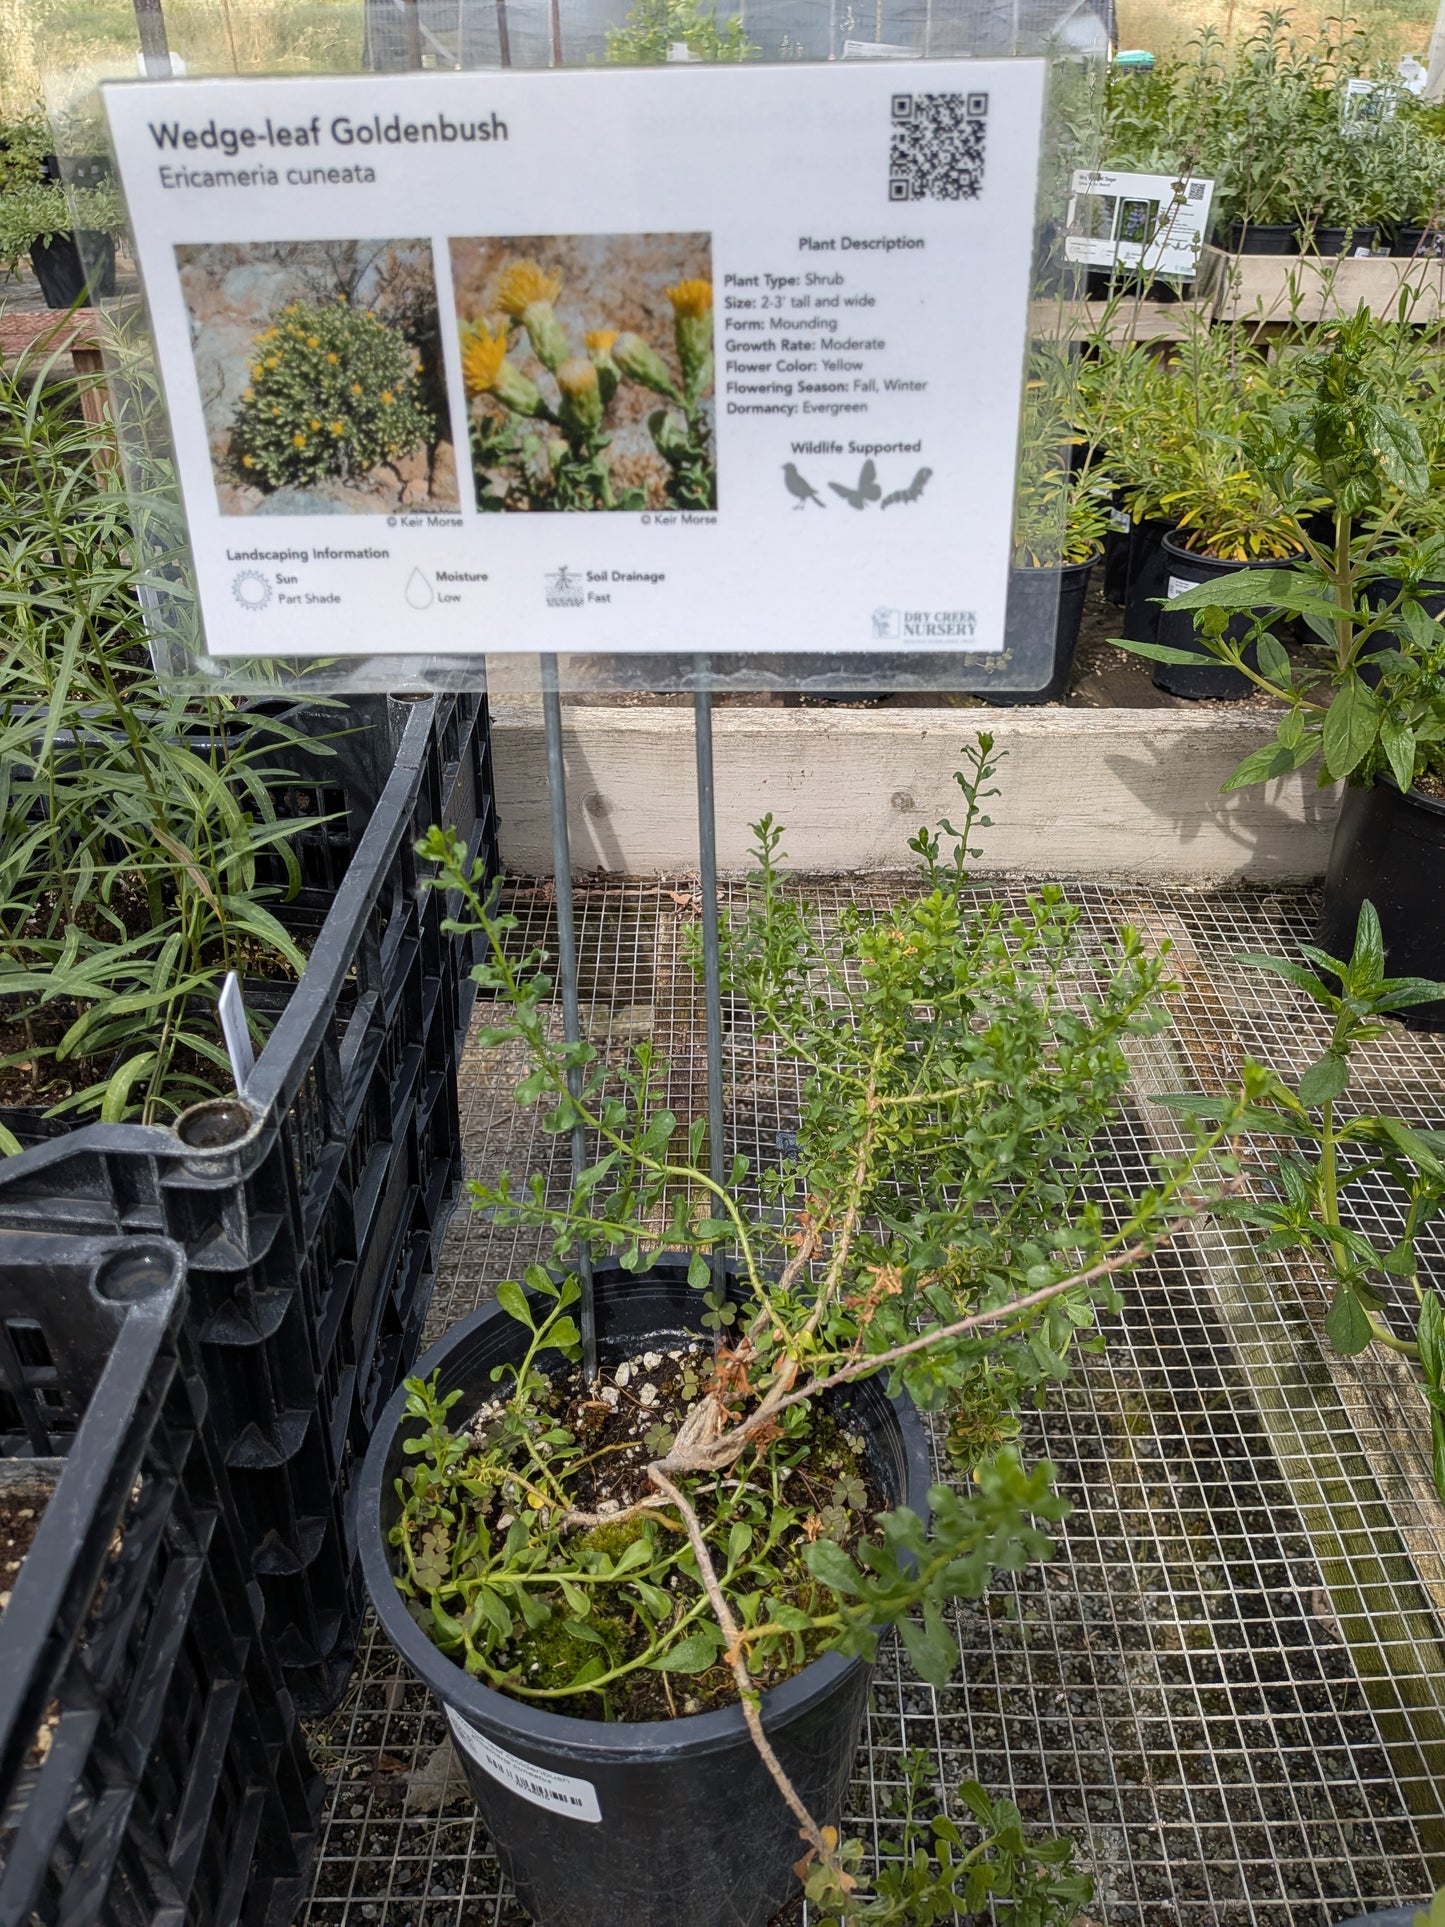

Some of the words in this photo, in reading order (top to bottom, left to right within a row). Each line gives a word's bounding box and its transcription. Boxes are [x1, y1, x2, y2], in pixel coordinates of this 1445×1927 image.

[148, 116, 320, 156] Wedge-leaf
[331, 113, 508, 146] Goldenbush
[158, 163, 279, 189] Ericameria
[286, 164, 376, 185] cuneata
[799, 237, 835, 251] Plant
[841, 237, 925, 253] Description
[724, 274, 759, 287] Plant
[764, 274, 800, 290] Type:
[804, 272, 844, 286] Shrub
[724, 297, 756, 310] Size:
[760, 296, 787, 309] 2-3'
[791, 295, 810, 308] tall
[814, 295, 840, 308] and
[844, 294, 876, 307] wide
[725, 318, 765, 331] Form:
[770, 317, 838, 332] Mounding
[725, 339, 776, 353] Growth
[781, 339, 816, 352] Rate:
[820, 338, 886, 351] Moderate
[726, 360, 771, 373] Flower
[776, 359, 817, 372] Color:
[821, 358, 864, 371] Yellow
[726, 381, 793, 396] Flowering
[797, 380, 849, 393] Season:
[853, 379, 879, 393] Fall,
[883, 379, 928, 392] Winter
[727, 402, 798, 417] Dormancy:
[802, 401, 868, 416] Evergreen
[790, 440, 843, 455] Wildlife
[847, 440, 922, 457] Supported
[401, 516, 424, 528] Keir
[427, 516, 464, 528] Morse
[654, 514, 678, 526] Keir
[680, 514, 717, 526] Morse
[226, 548, 309, 563] Landscaping
[312, 547, 390, 560] Information
[276, 573, 298, 585] Sun
[436, 571, 489, 583] Moisture
[586, 570, 608, 583] Soil
[611, 570, 665, 585] Drainage
[278, 593, 302, 605] Part
[304, 593, 341, 605] Shade
[437, 592, 461, 603] Low
[587, 592, 611, 603] Fast
[904, 611, 931, 623] DRY
[934, 611, 977, 622] CREEK
[904, 624, 976, 636] NURSERY
